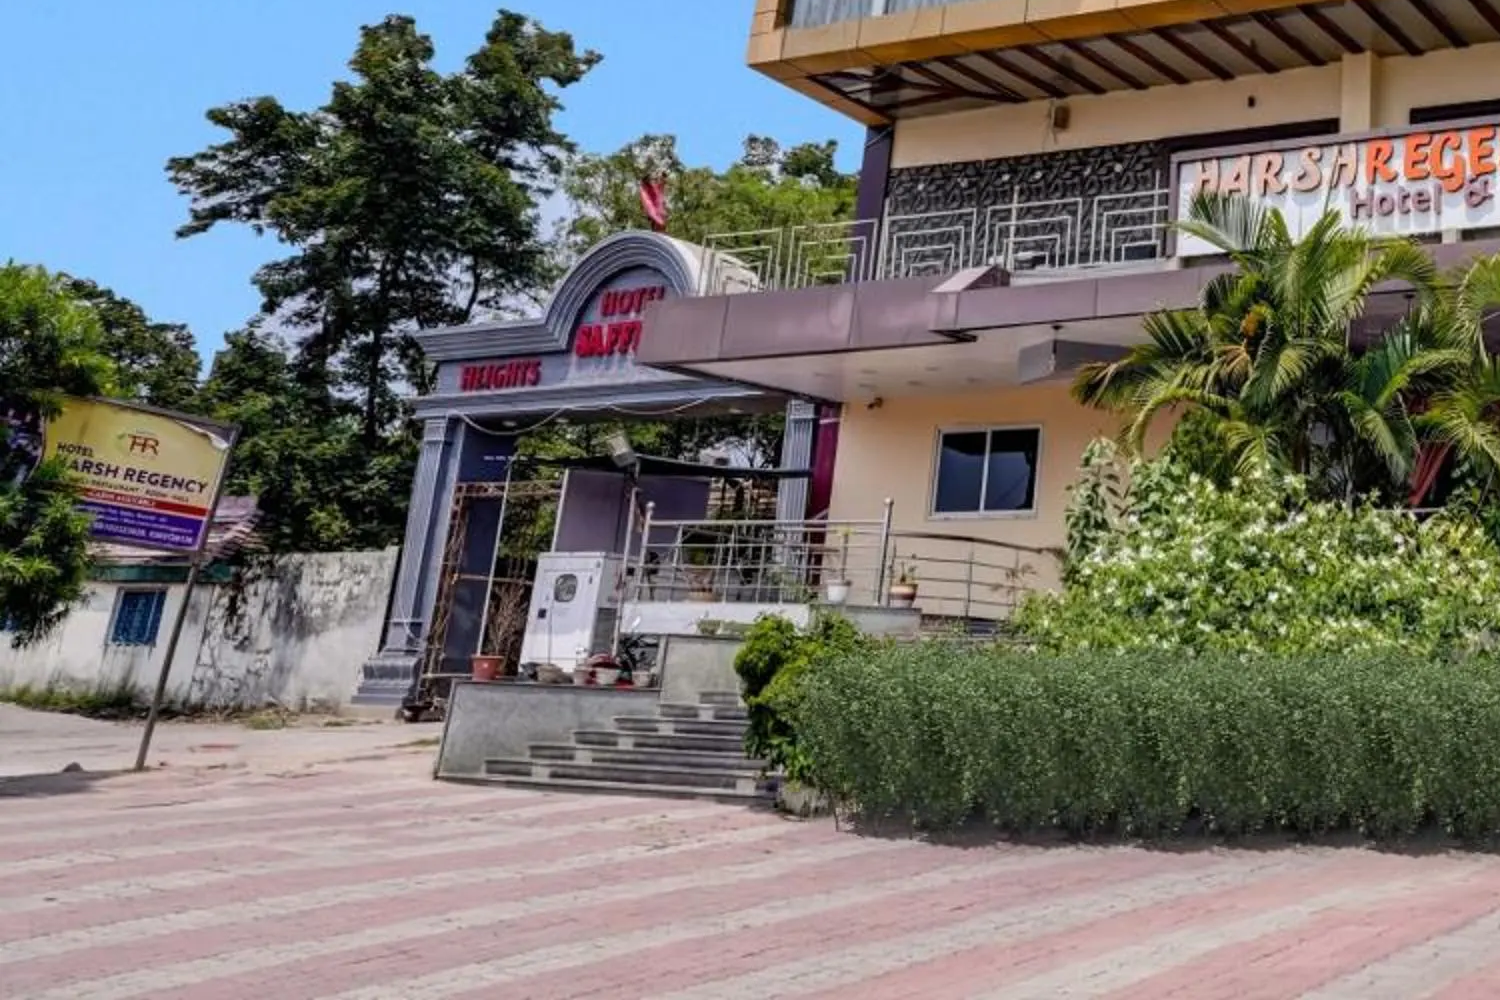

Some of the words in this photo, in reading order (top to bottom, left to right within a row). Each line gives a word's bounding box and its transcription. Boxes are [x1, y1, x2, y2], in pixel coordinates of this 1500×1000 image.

[1350, 182, 1442, 219] Hotel
[1464, 172, 1494, 207] &
[460, 360, 542, 391] HEIGHTS
[57, 441, 94, 458] HOTEL
[69, 458, 119, 480] ARSH
[123, 467, 208, 494] REGENCY
